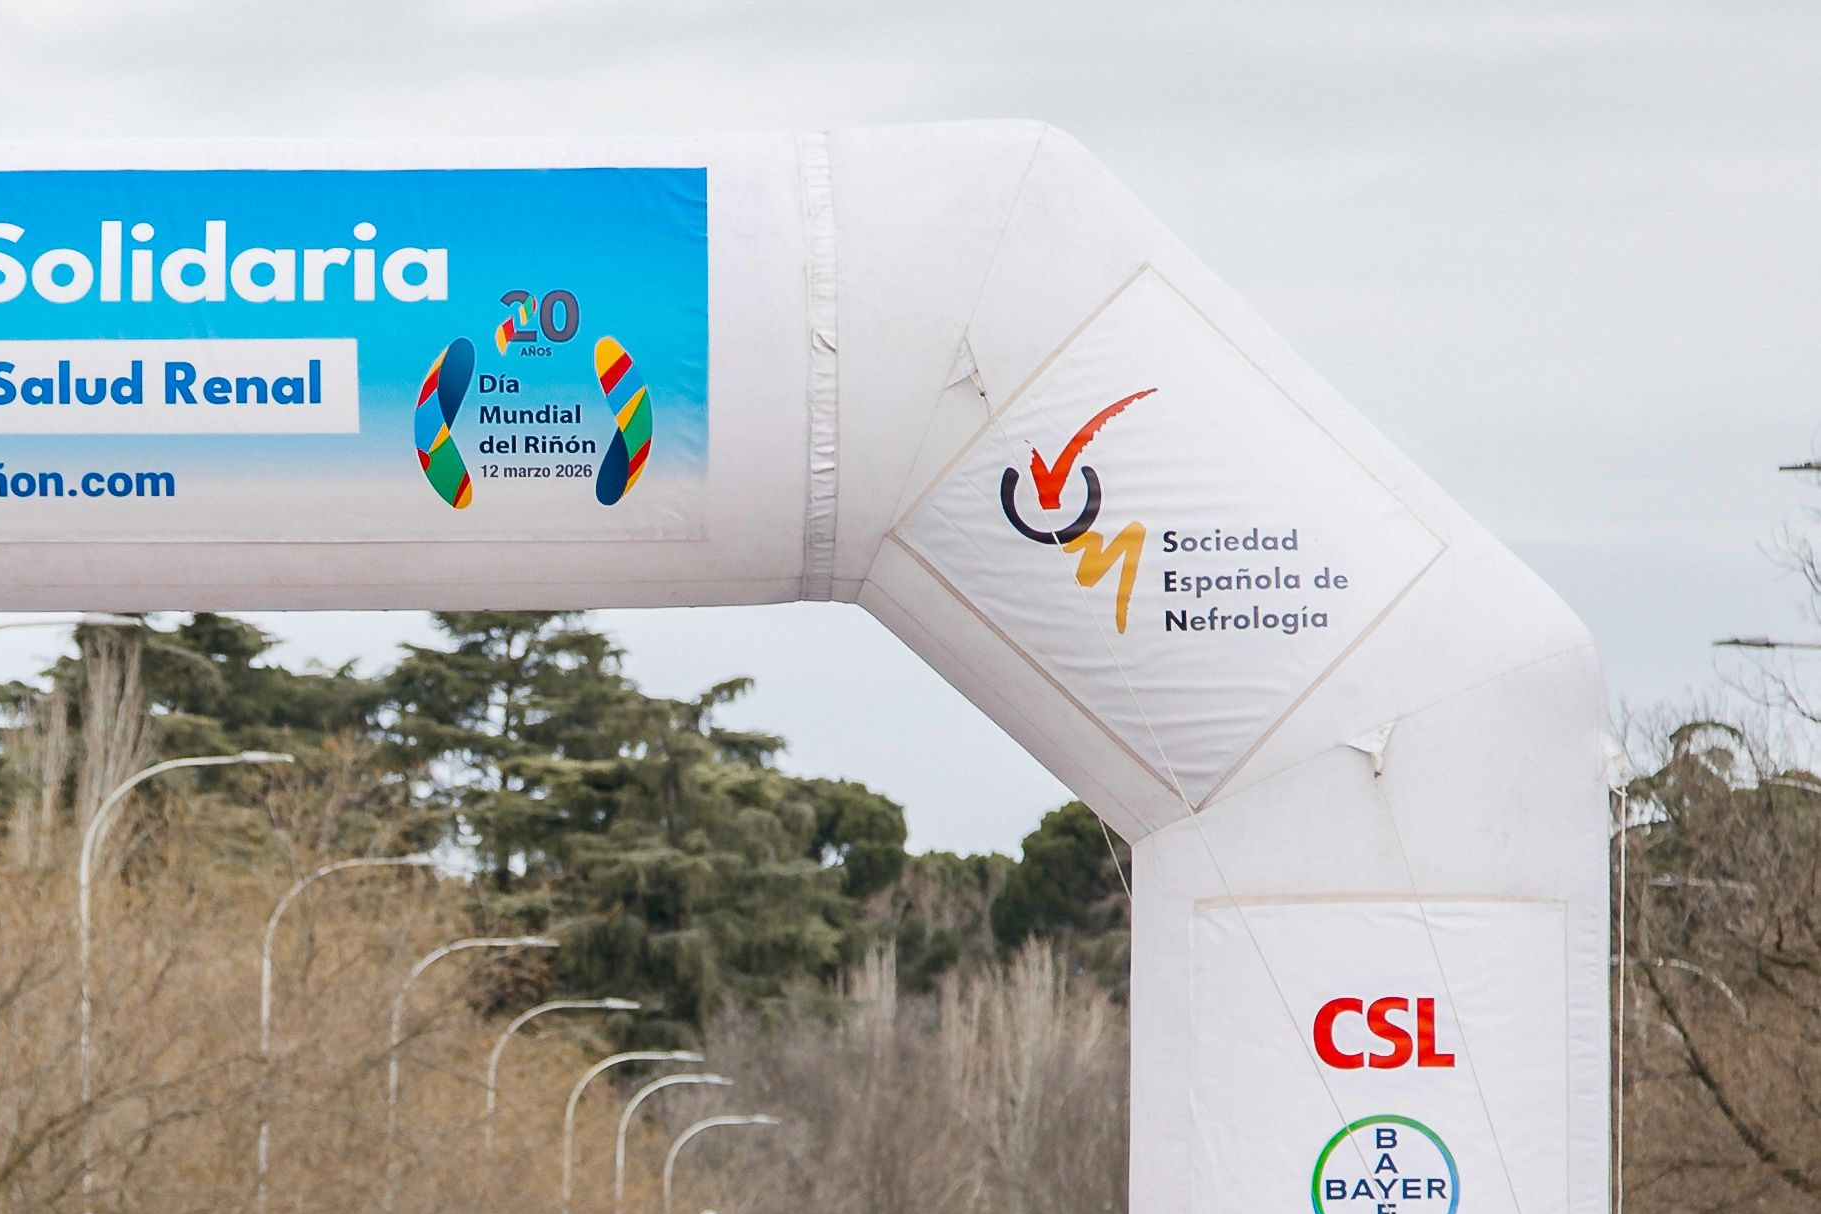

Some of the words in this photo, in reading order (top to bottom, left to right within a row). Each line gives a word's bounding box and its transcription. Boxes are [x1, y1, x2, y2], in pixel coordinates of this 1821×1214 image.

[520, 346, 552, 357] AÑOS
[164, 360, 322, 406] Renal
[479, 374, 520, 393] Día
[479, 405, 581, 424] Mundial
[479, 435, 517, 454] del
[525, 435, 596, 454] Riñón
[481, 464, 499, 478] 12
[503, 467, 551, 478] marzo
[556, 464, 593, 478] 2026
[1163, 528, 1298, 552] Sociedad
[1164, 567, 1300, 598] Española
[1314, 567, 1349, 590] de
[1165, 606, 1329, 634] Nefrología
[1313, 997, 1456, 1069] CSL
[1326, 1178, 1447, 1200] BAYER
